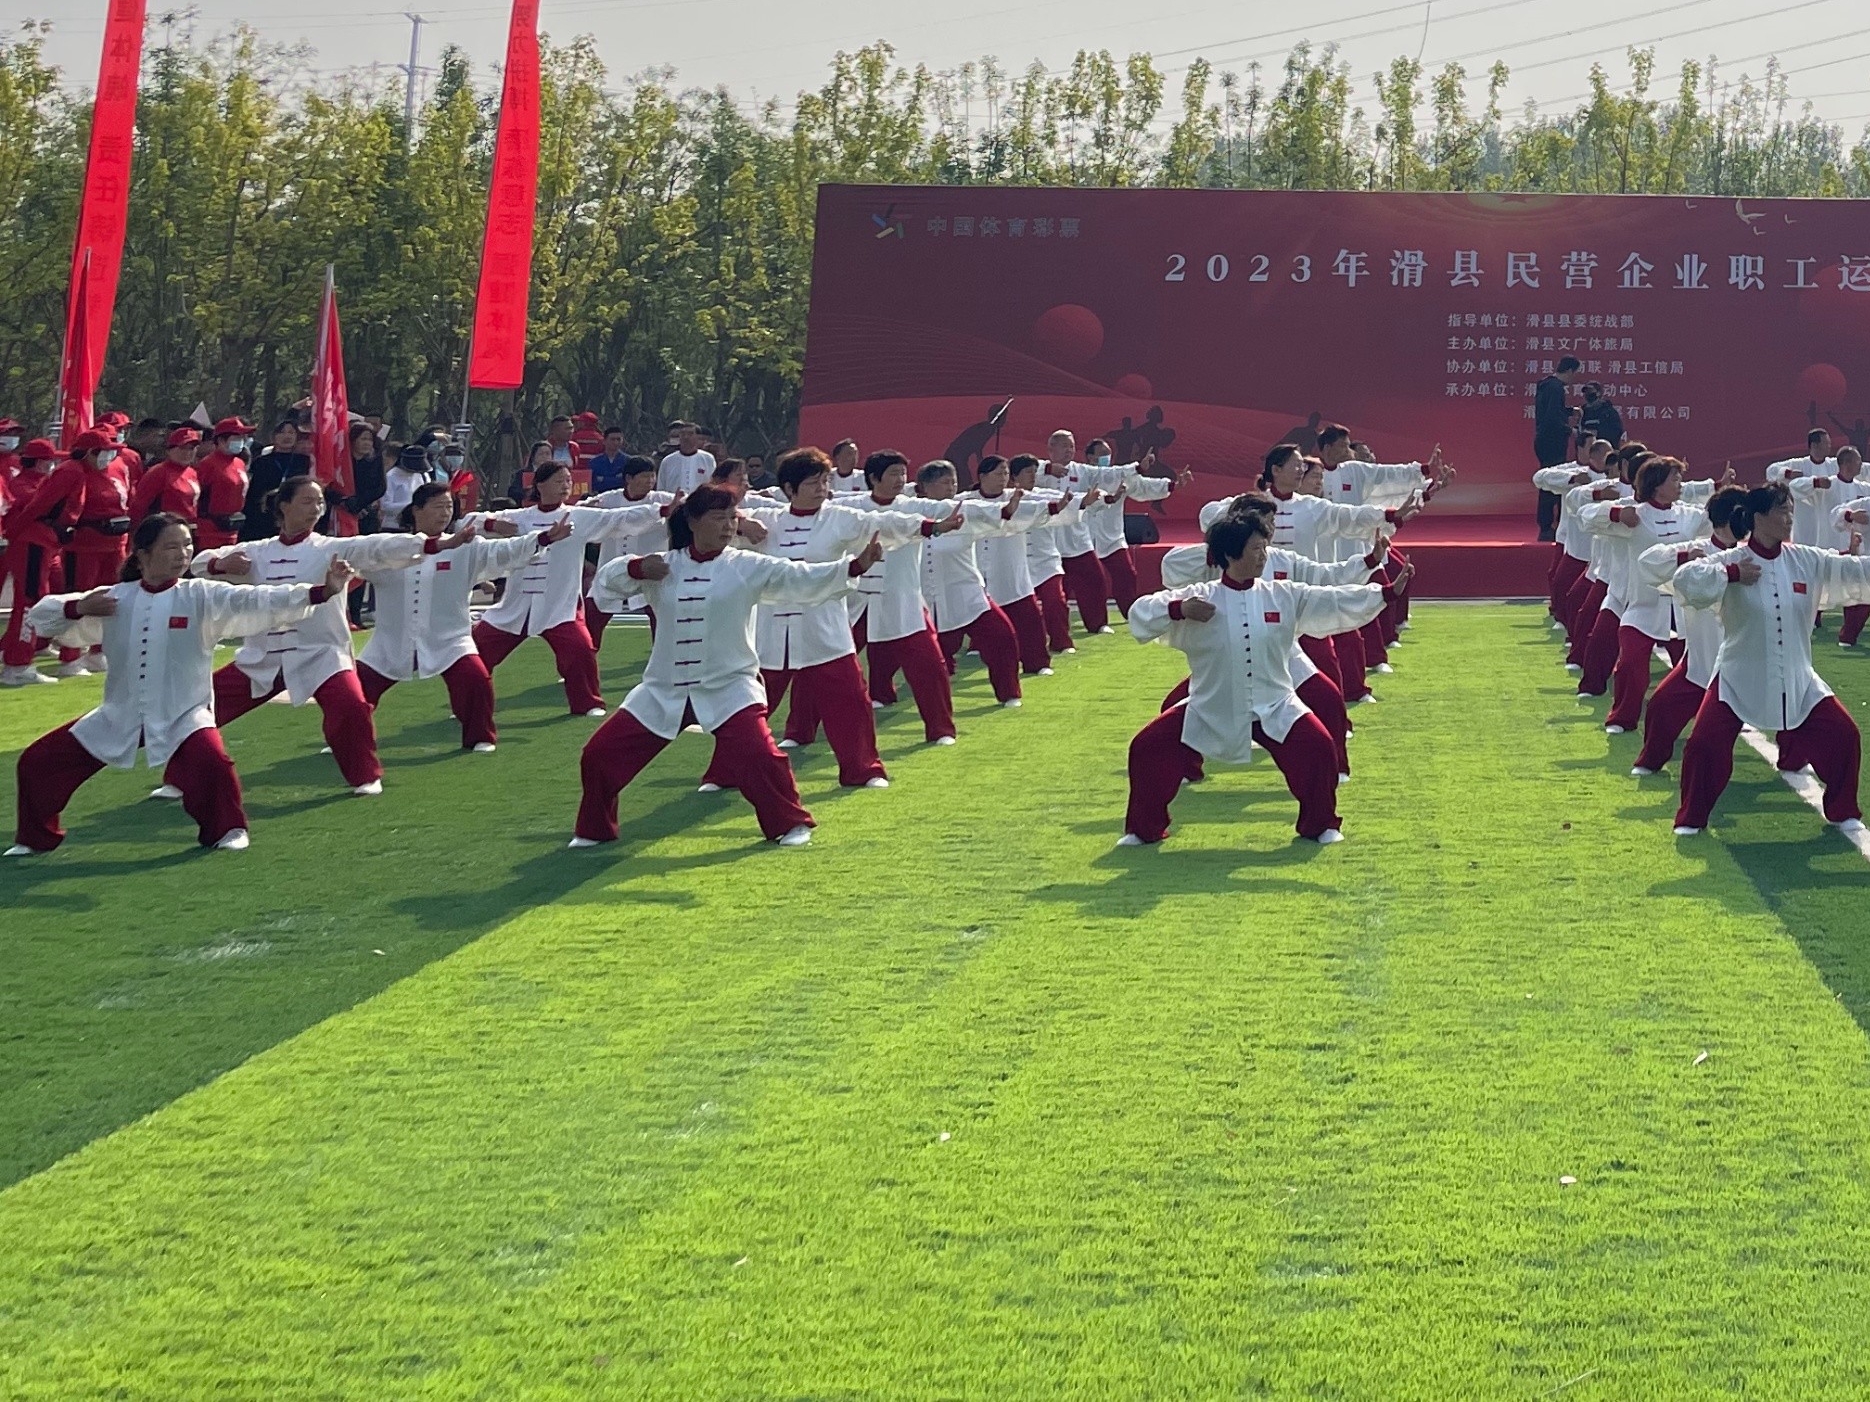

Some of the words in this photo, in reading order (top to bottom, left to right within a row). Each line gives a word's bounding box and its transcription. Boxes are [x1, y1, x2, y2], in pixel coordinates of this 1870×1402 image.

[926, 215, 1081, 238] 中国体育彩票
